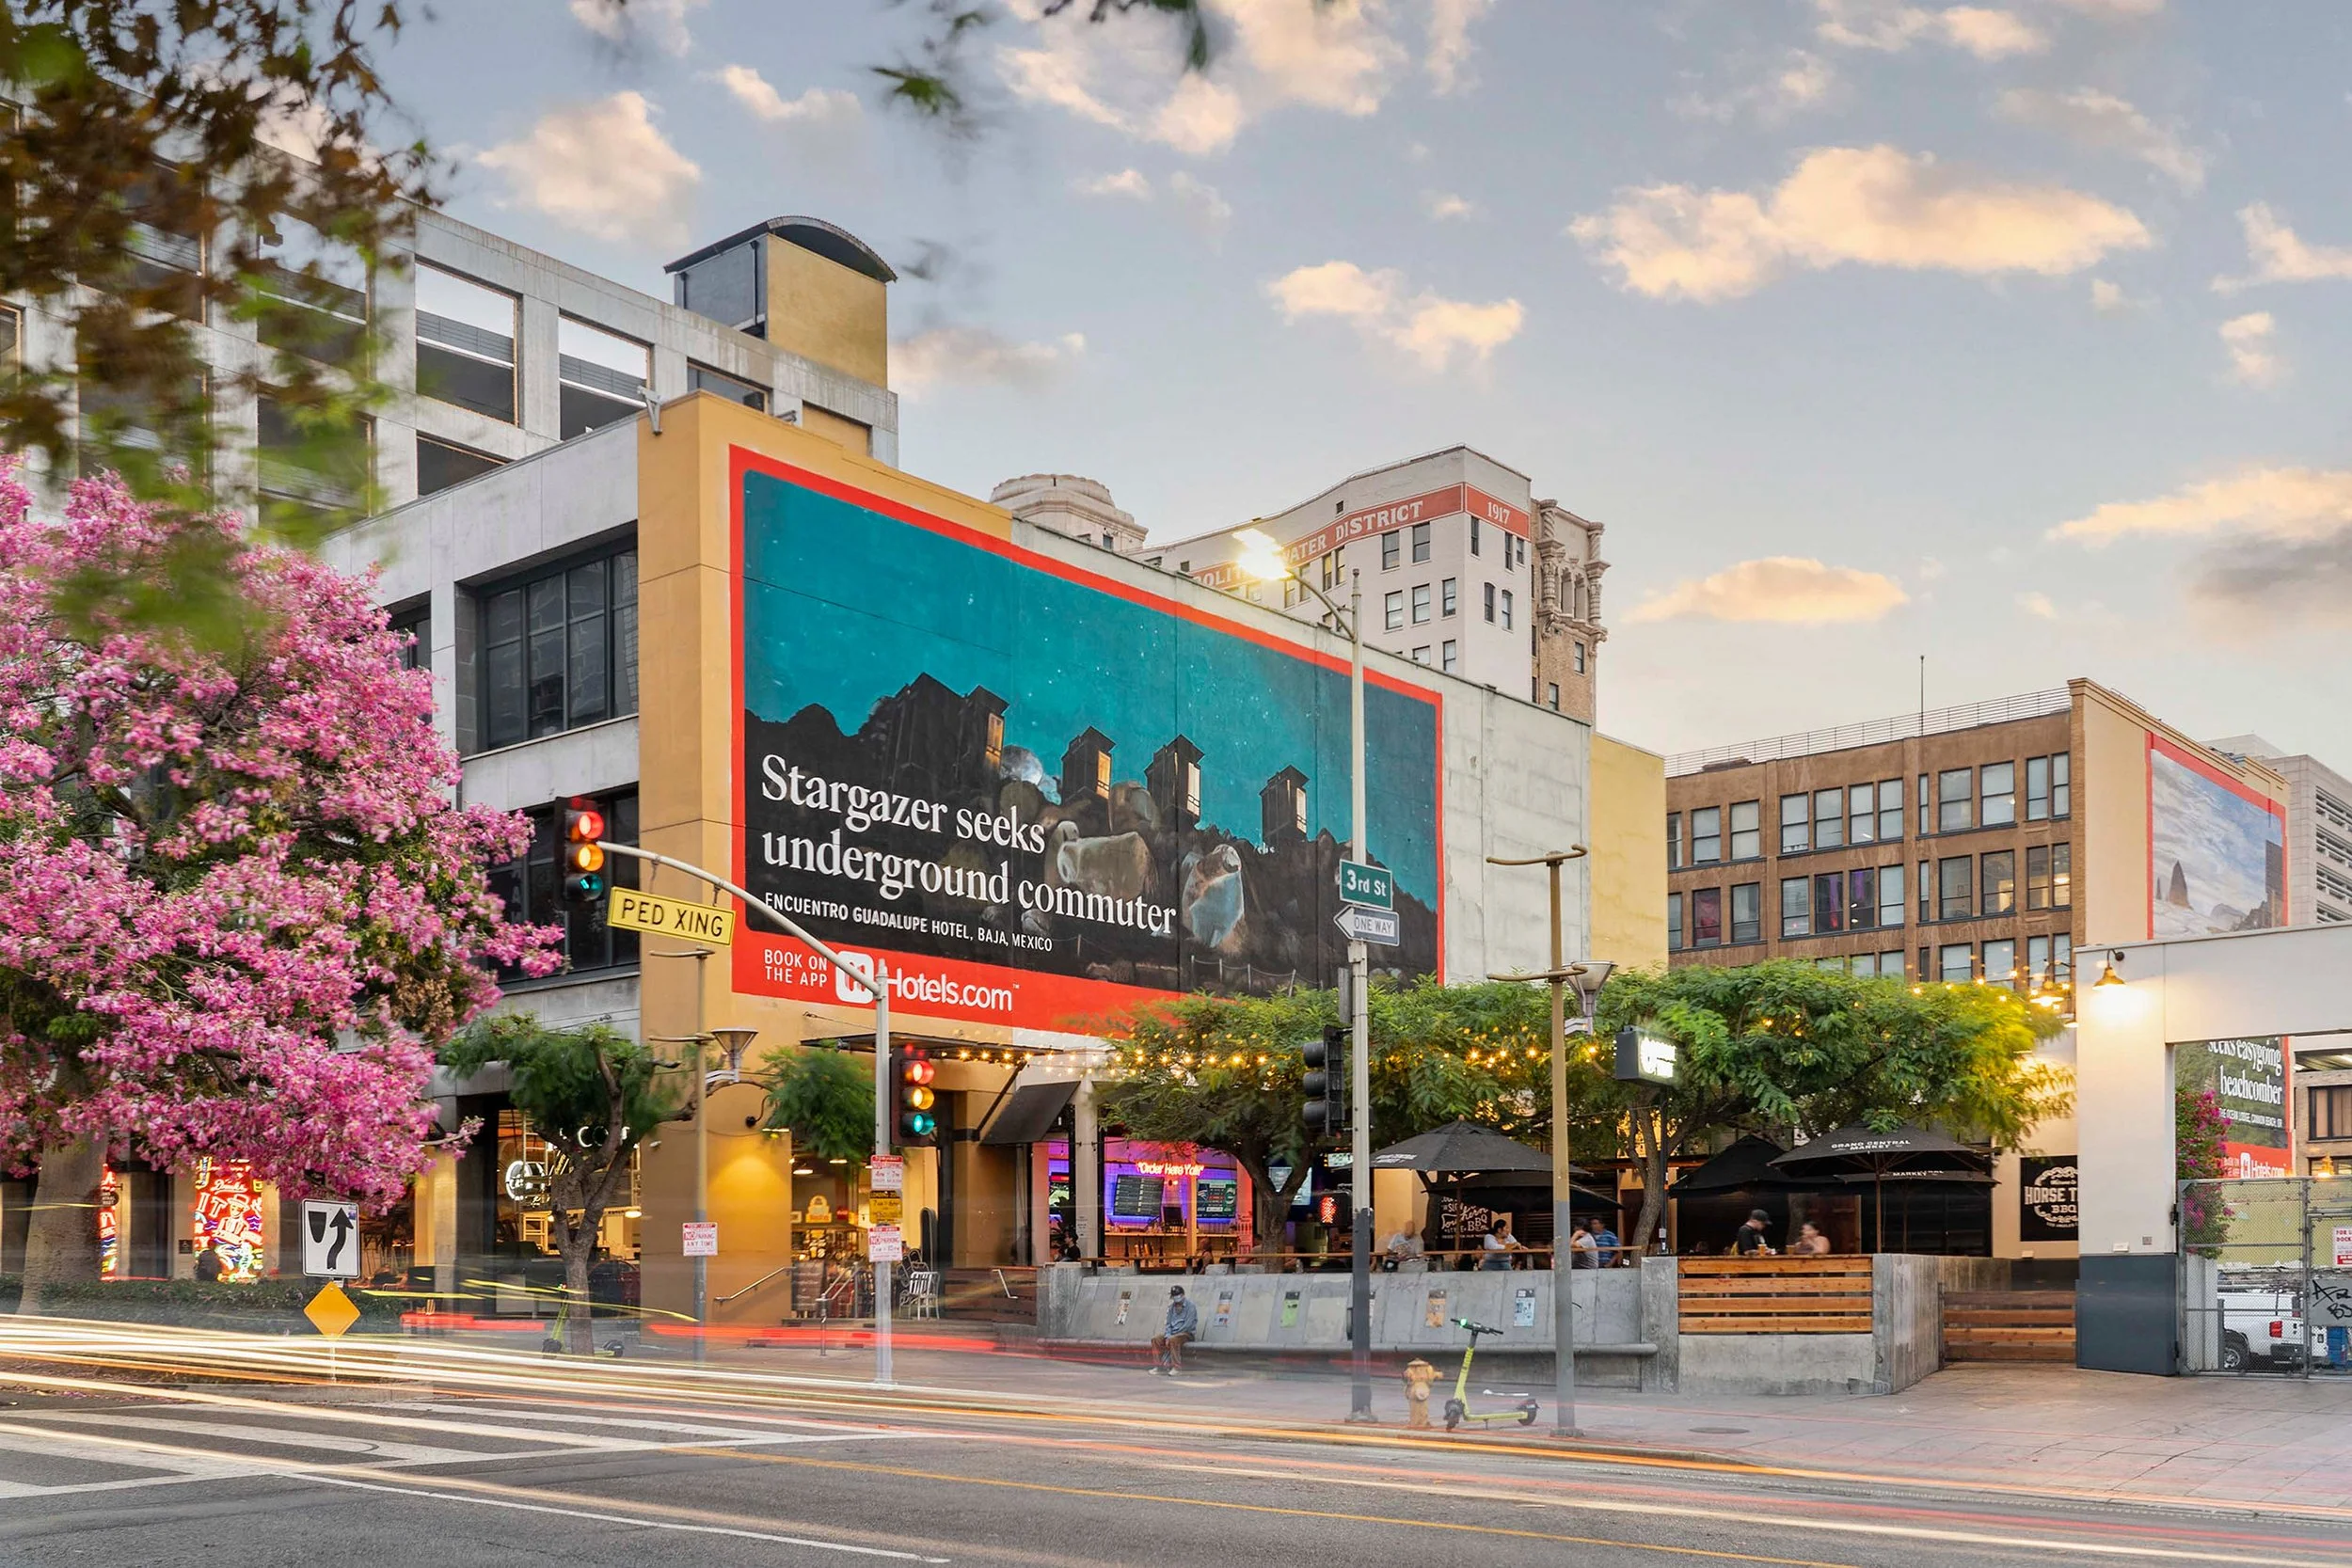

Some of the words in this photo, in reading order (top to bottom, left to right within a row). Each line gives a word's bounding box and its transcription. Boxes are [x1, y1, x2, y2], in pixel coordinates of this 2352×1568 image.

[1335, 500, 1423, 542] DISTRICT
[1486, 501, 1511, 525] 1917
[762, 753, 947, 832] Stargazer
[956, 805, 1045, 854] seeks
[762, 829, 1009, 904] underground
[1018, 879, 1176, 934] commuter
[1346, 869, 1370, 894] 3rd
[1374, 879, 1387, 897] St
[622, 898, 664, 926] PED
[675, 909, 723, 937] XING
[765, 893, 849, 921] ENCUENTRO
[852, 907, 929, 933] GUADALUPE
[931, 920, 974, 942] HOTEL,
[977, 927, 1009, 947] BAJA,
[1011, 933, 1053, 952] MEXICO
[1355, 917, 1373, 931] ONE
[1375, 920, 1392, 934] WAY
[764, 949, 803, 969] BOOK
[809, 956, 827, 972] ON
[765, 965, 793, 984] THE
[800, 972, 827, 988] APP
[2220, 1065, 2282, 1105] beachcomber
[2025, 1186, 2066, 1205] HORSE
[2051, 1205, 2077, 1213] BBQ
[1468, 1214, 1487, 1231] BBQ
